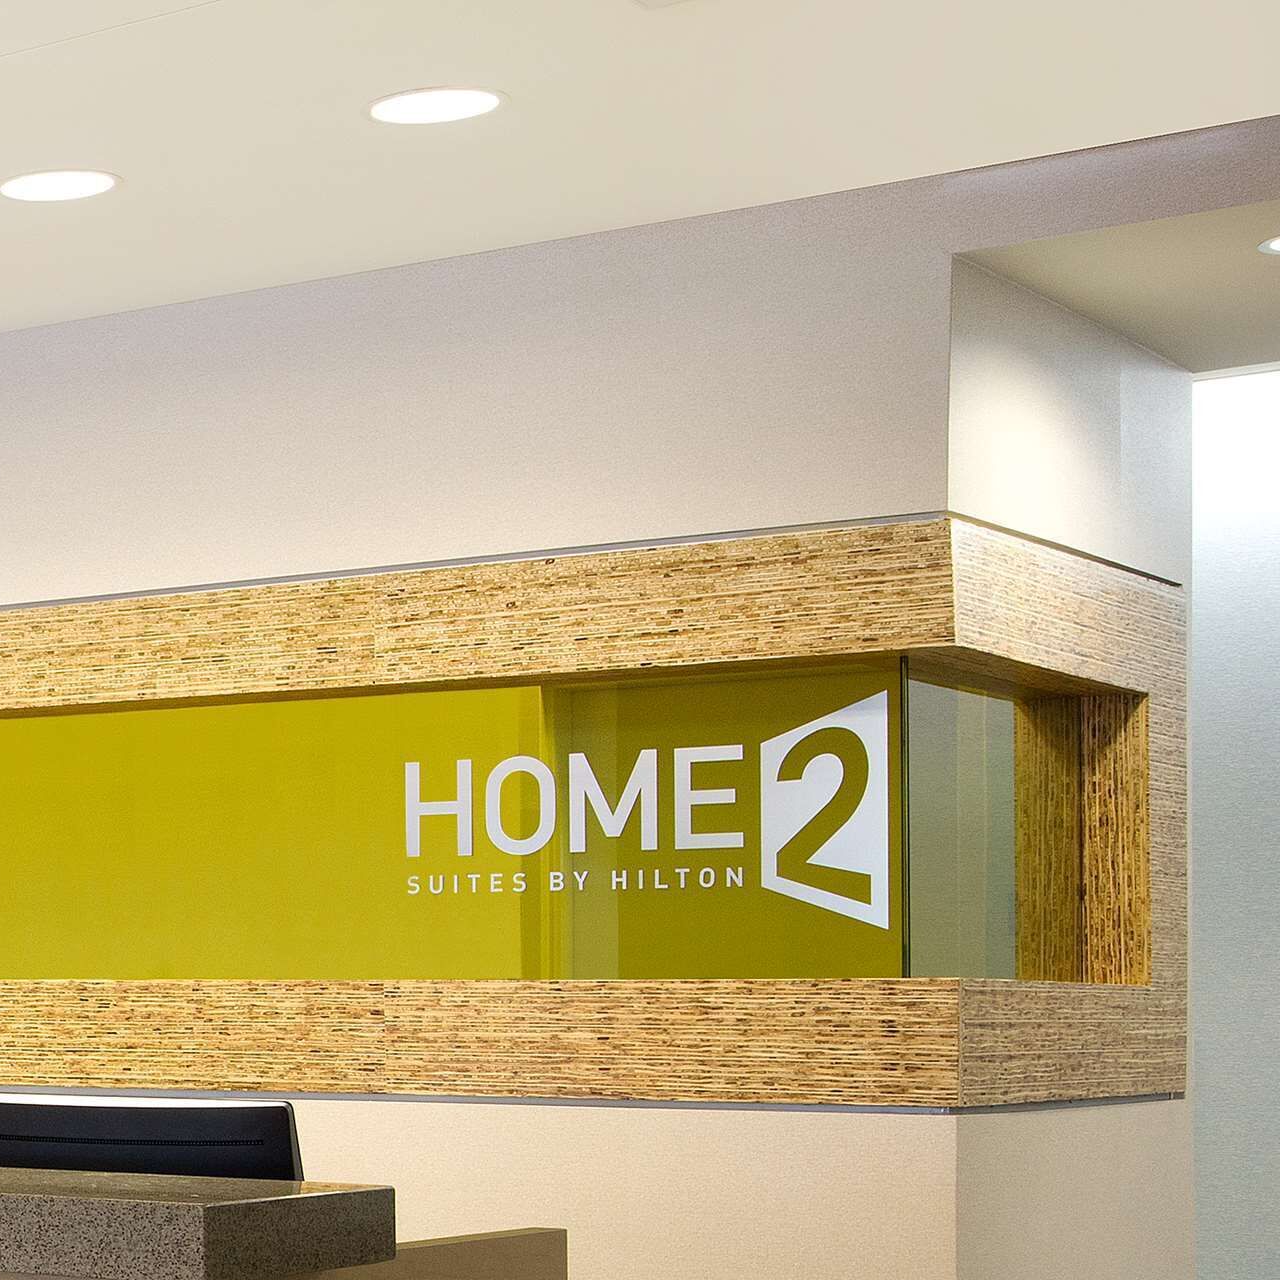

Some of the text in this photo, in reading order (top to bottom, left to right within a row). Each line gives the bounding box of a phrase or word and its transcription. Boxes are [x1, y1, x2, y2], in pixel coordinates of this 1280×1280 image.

[407, 867, 745, 895] SUITES BY HILTON
